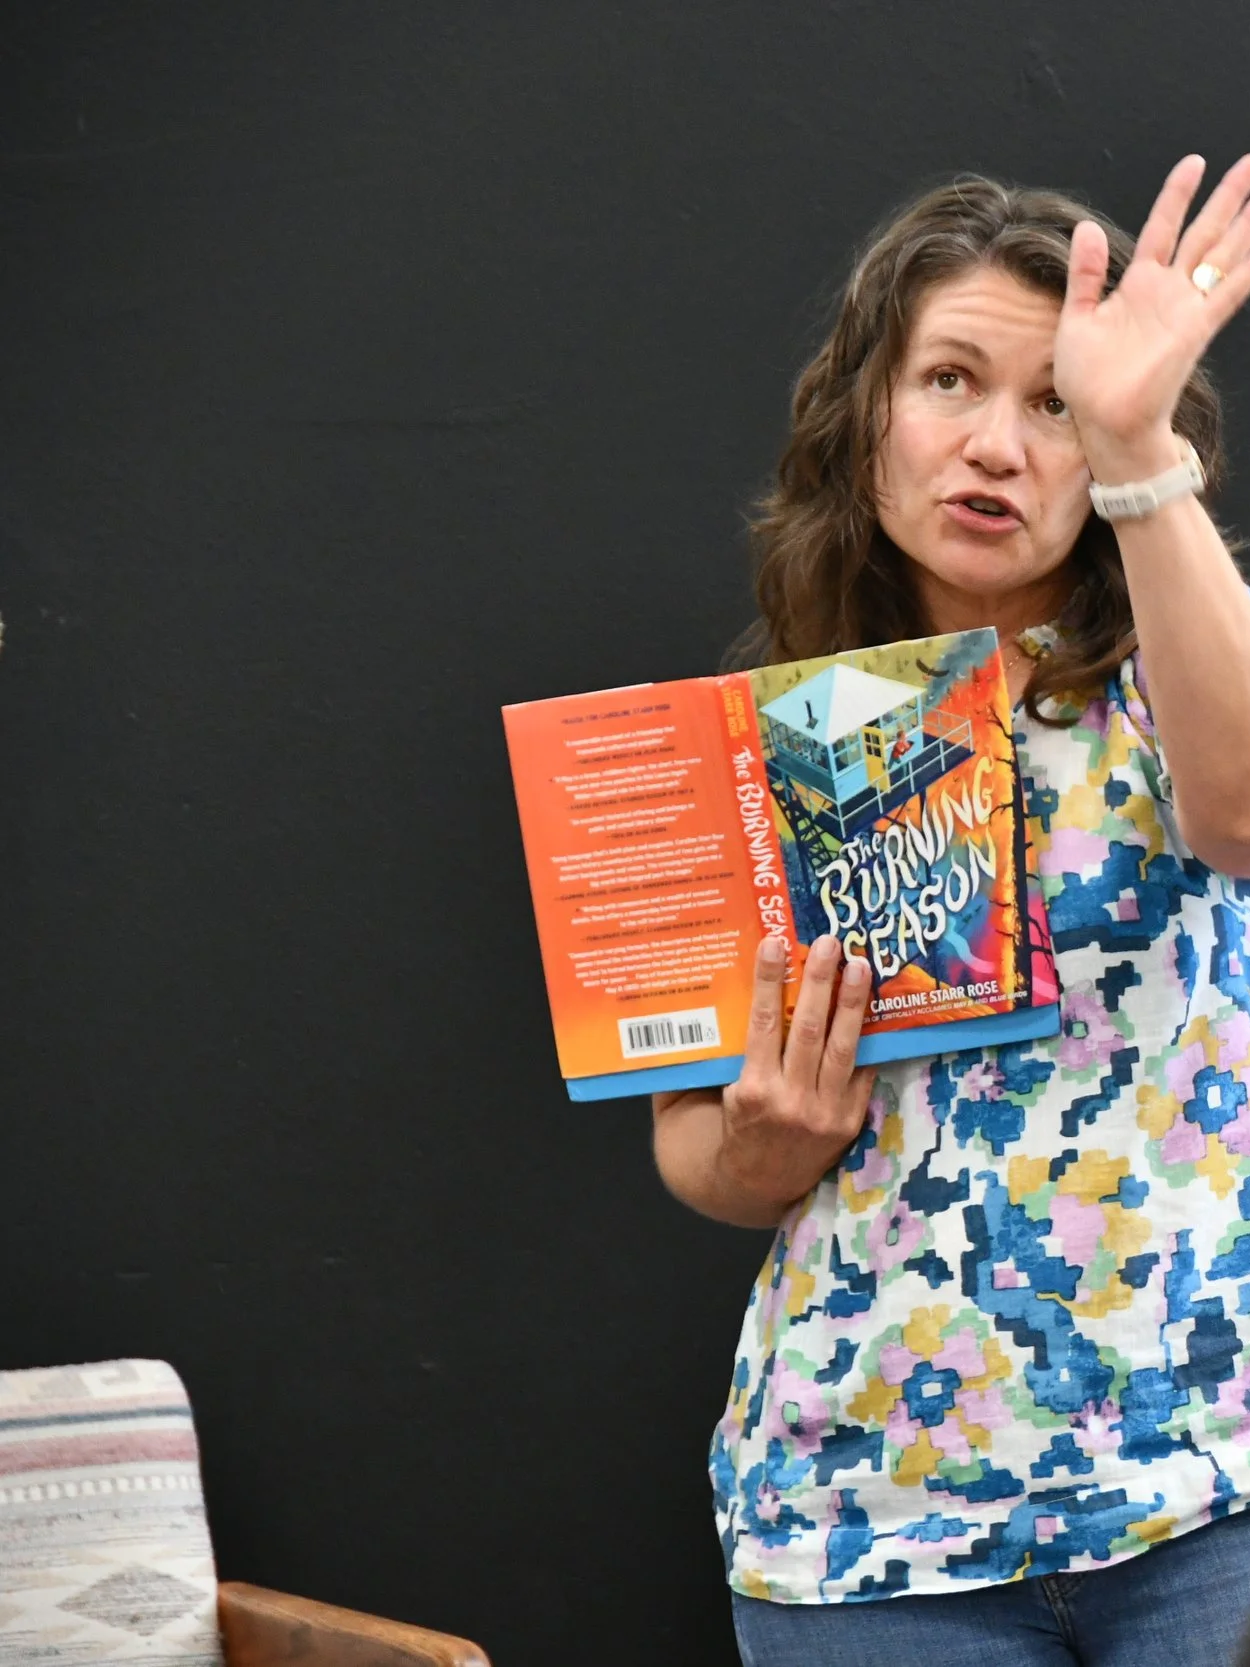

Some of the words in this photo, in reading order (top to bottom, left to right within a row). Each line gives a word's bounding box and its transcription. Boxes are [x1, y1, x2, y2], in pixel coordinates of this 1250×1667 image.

[732, 745, 756, 779] The
[735, 782, 780, 888] BURNING
[815, 751, 994, 936] BURNING
[839, 831, 882, 870] The
[843, 827, 996, 979] SEASON
[870, 991, 928, 1013] CAROLINE
[929, 986, 965, 1003] STARR
[967, 980, 999, 997] ROSE
[881, 1009, 917, 1021] CRITICALLY
[917, 1003, 953, 1014] ACCLAIMED
